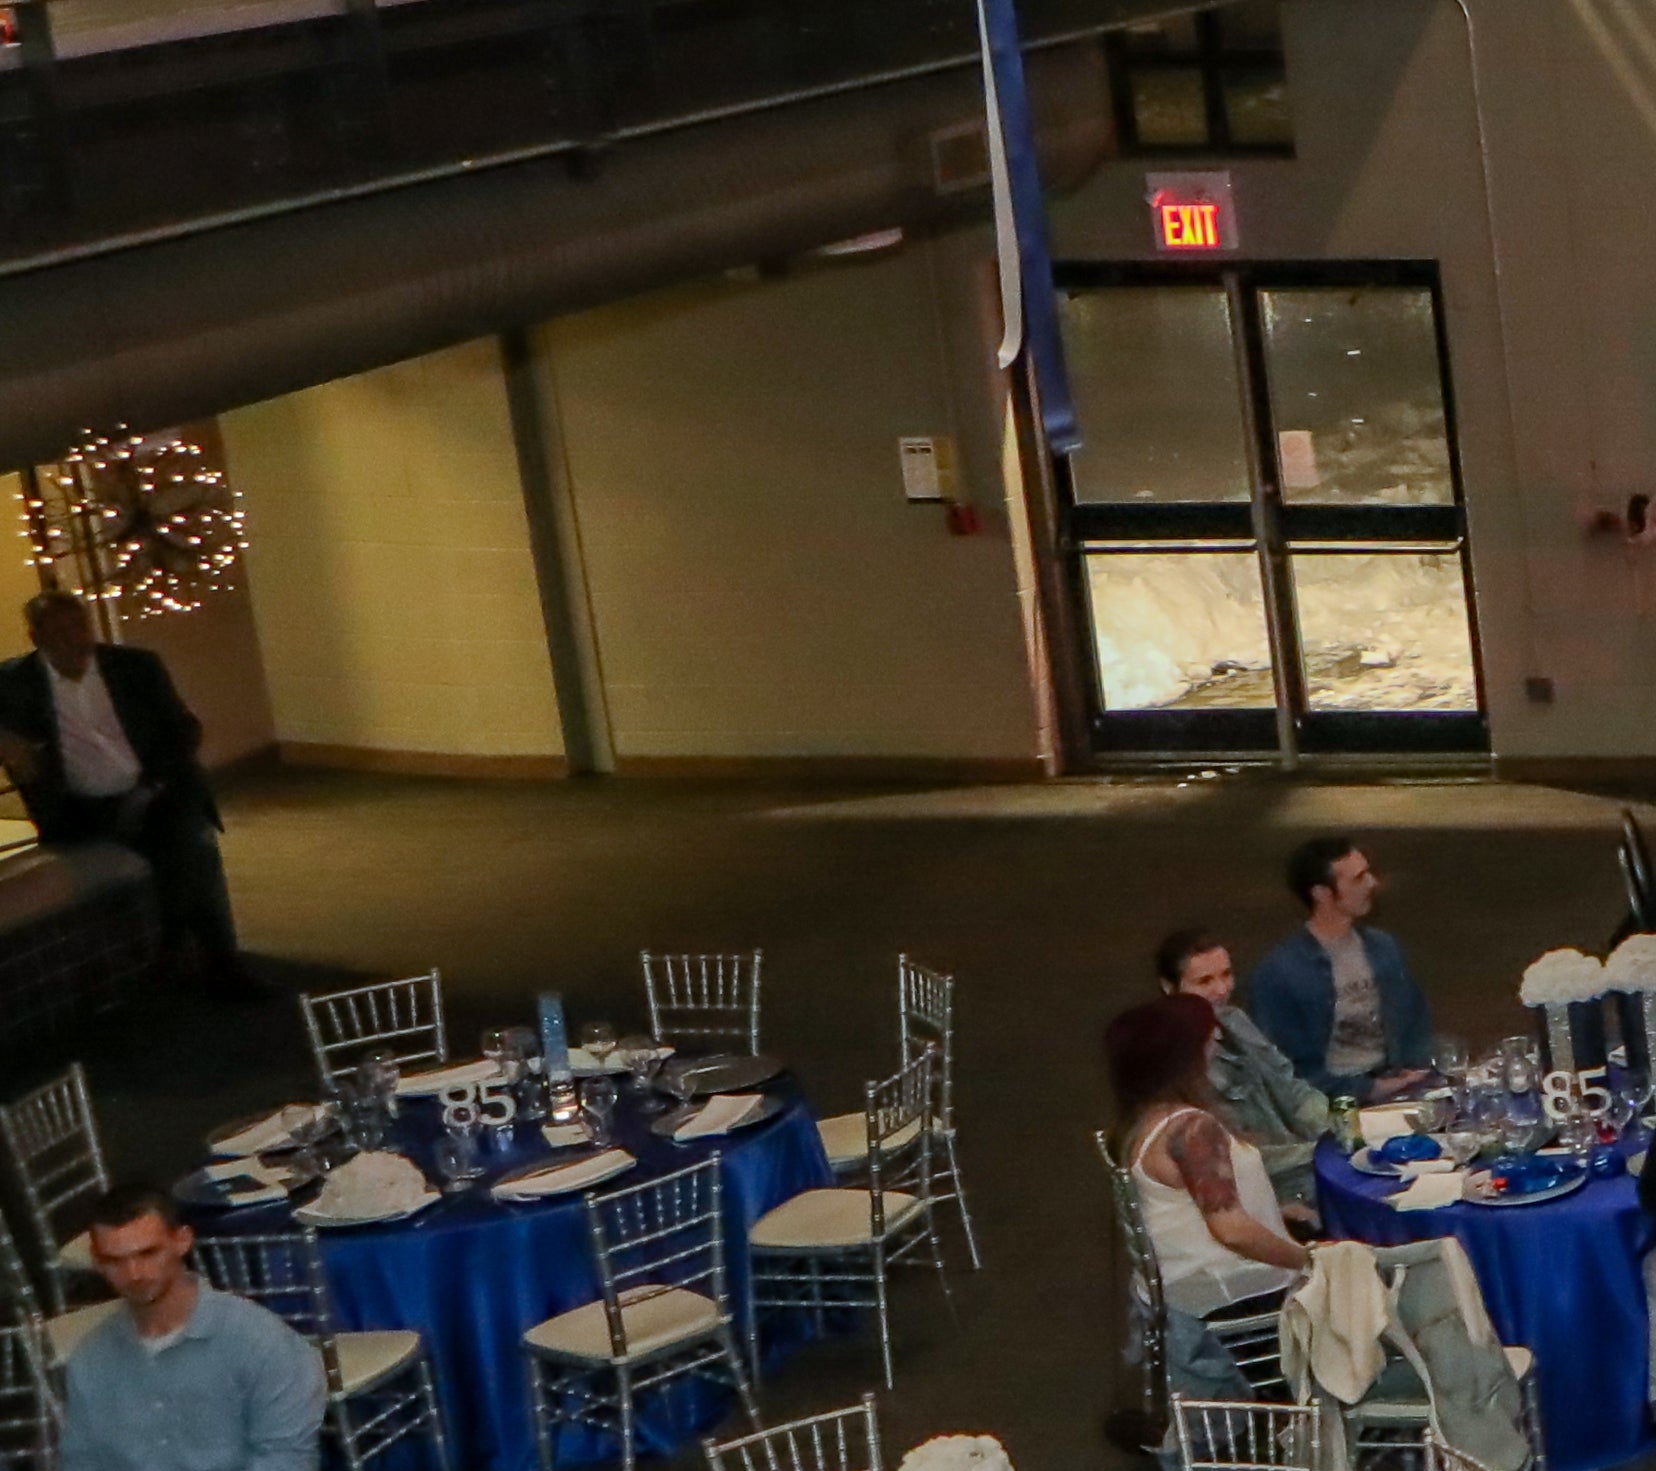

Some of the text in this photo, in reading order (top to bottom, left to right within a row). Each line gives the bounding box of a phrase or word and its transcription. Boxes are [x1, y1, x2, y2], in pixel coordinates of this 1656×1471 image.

[1161, 205, 1216, 245] EXIT
[438, 1076, 517, 1126] 85
[1541, 1065, 1613, 1120] 85
